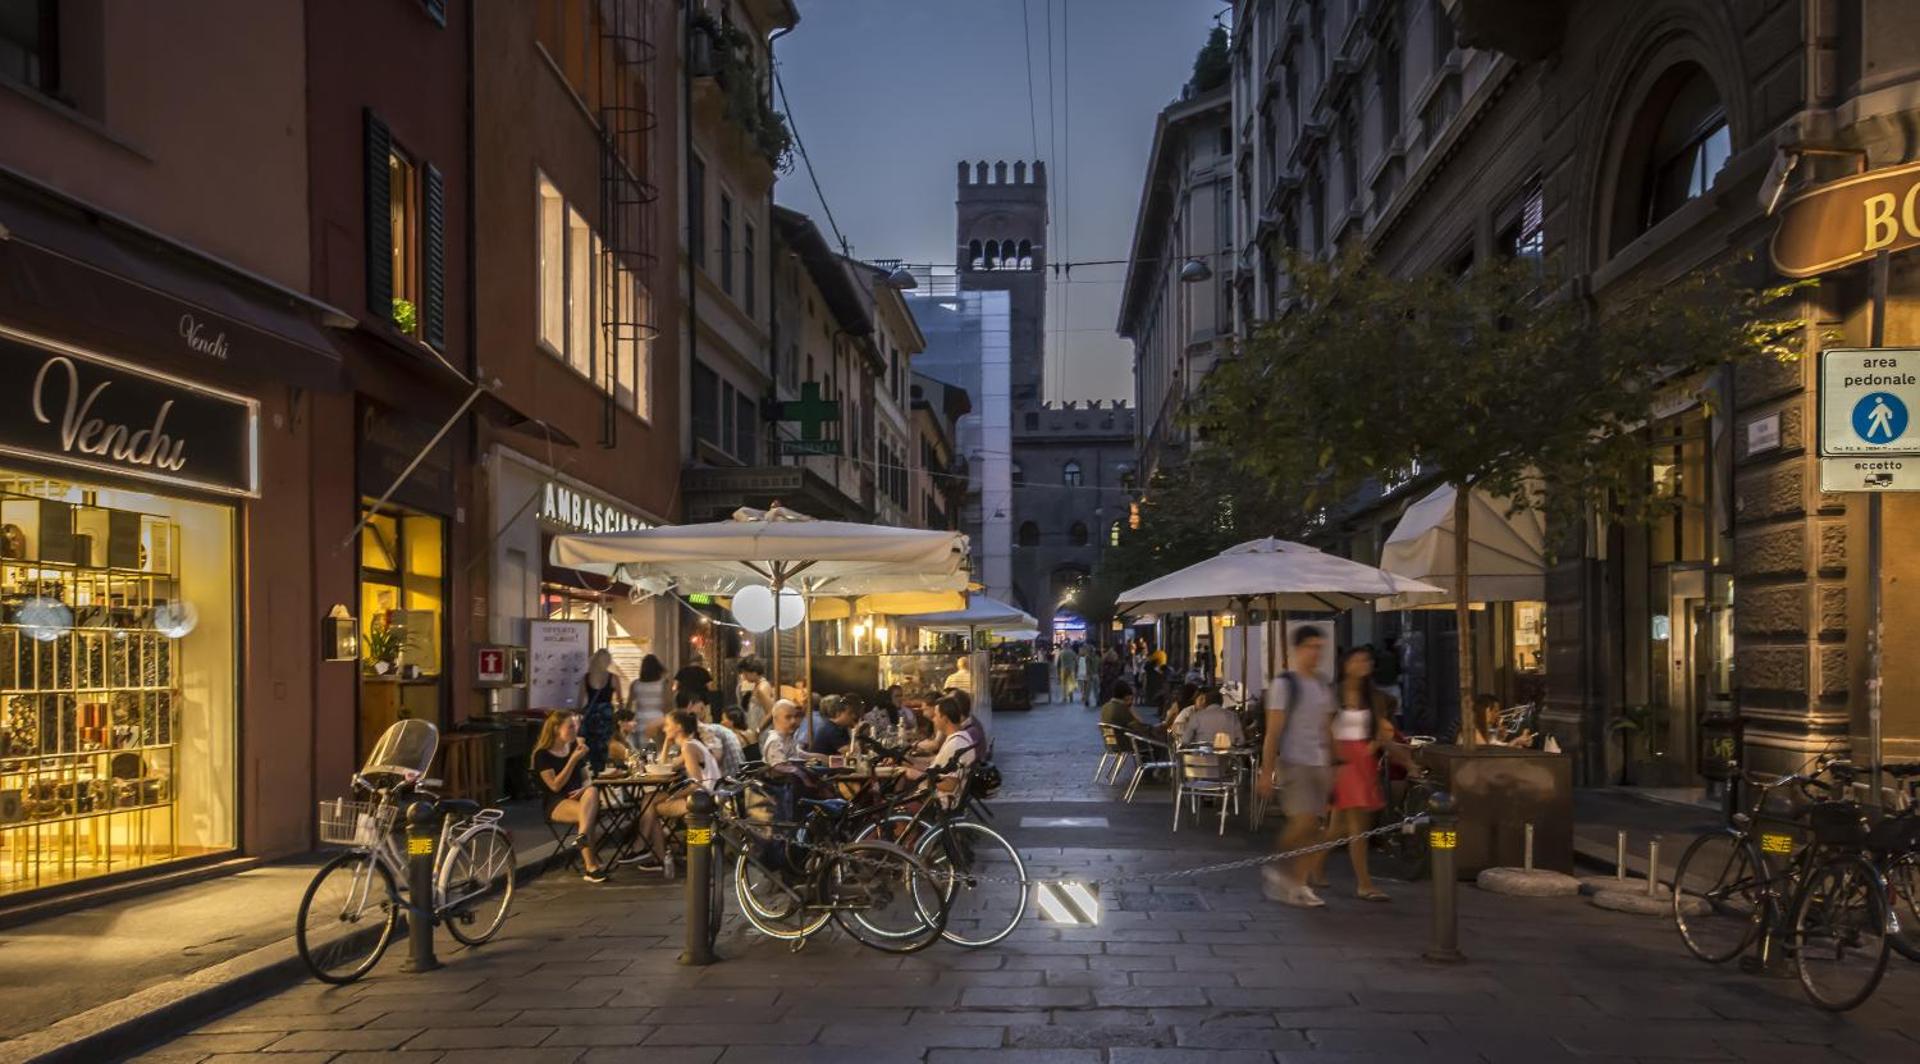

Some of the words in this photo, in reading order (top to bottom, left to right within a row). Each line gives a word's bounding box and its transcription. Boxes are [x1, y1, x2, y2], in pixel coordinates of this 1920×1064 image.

[179, 314, 229, 360] Venchi
[1863, 358, 1897, 368] area
[1844, 373, 1916, 388] pedonale
[33, 356, 186, 471] Venchi
[1854, 461, 1902, 470] eccetto
[544, 482, 655, 534] AMBASCIAT
